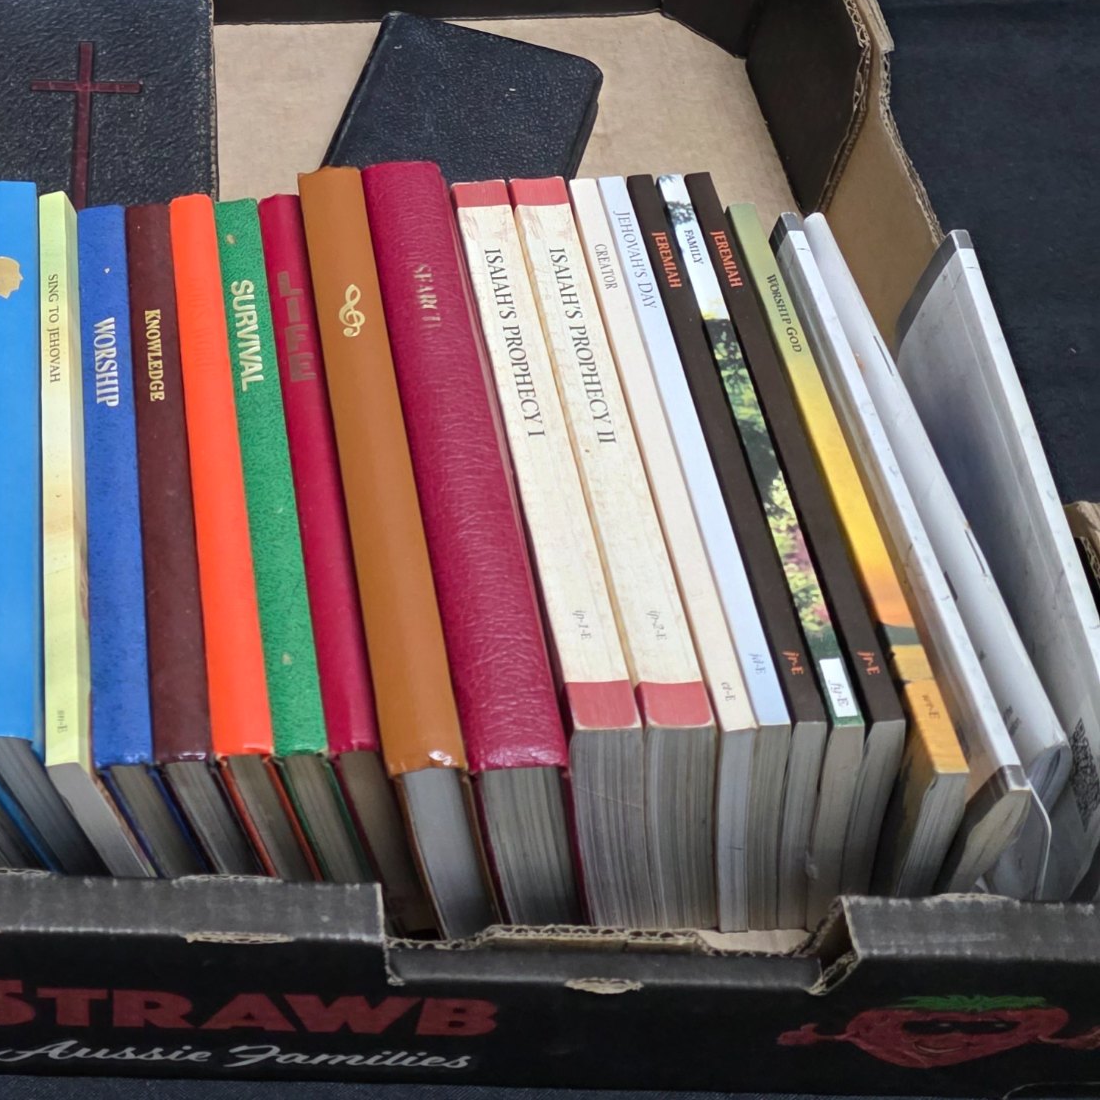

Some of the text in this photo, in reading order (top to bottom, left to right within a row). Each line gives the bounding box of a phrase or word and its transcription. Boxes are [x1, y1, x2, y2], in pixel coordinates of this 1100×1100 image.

[594, 243, 619, 290] CREATOR
[613, 210, 658, 309] JEHOVAH'S DAY
[652, 231, 683, 289] JEREMIAH
[683, 228, 704, 265] FAMILY
[709, 230, 743, 288] JEREMIAH
[47, 273, 61, 383] SING TO JEHOVAH
[144, 308, 165, 402] KNOWLEDGE
[230, 279, 265, 392] SURVIVAL
[277, 271, 317, 383] LIFE
[484, 248, 546, 438] ISAIAH'S PROPHECY I
[549, 247, 617, 445] ISAIAH'S PROPHECY II
[767, 274, 802, 353] WORSHIP GOD
[93, 317, 120, 407] WORSHIP
[223, 1044, 473, 1070] Families
